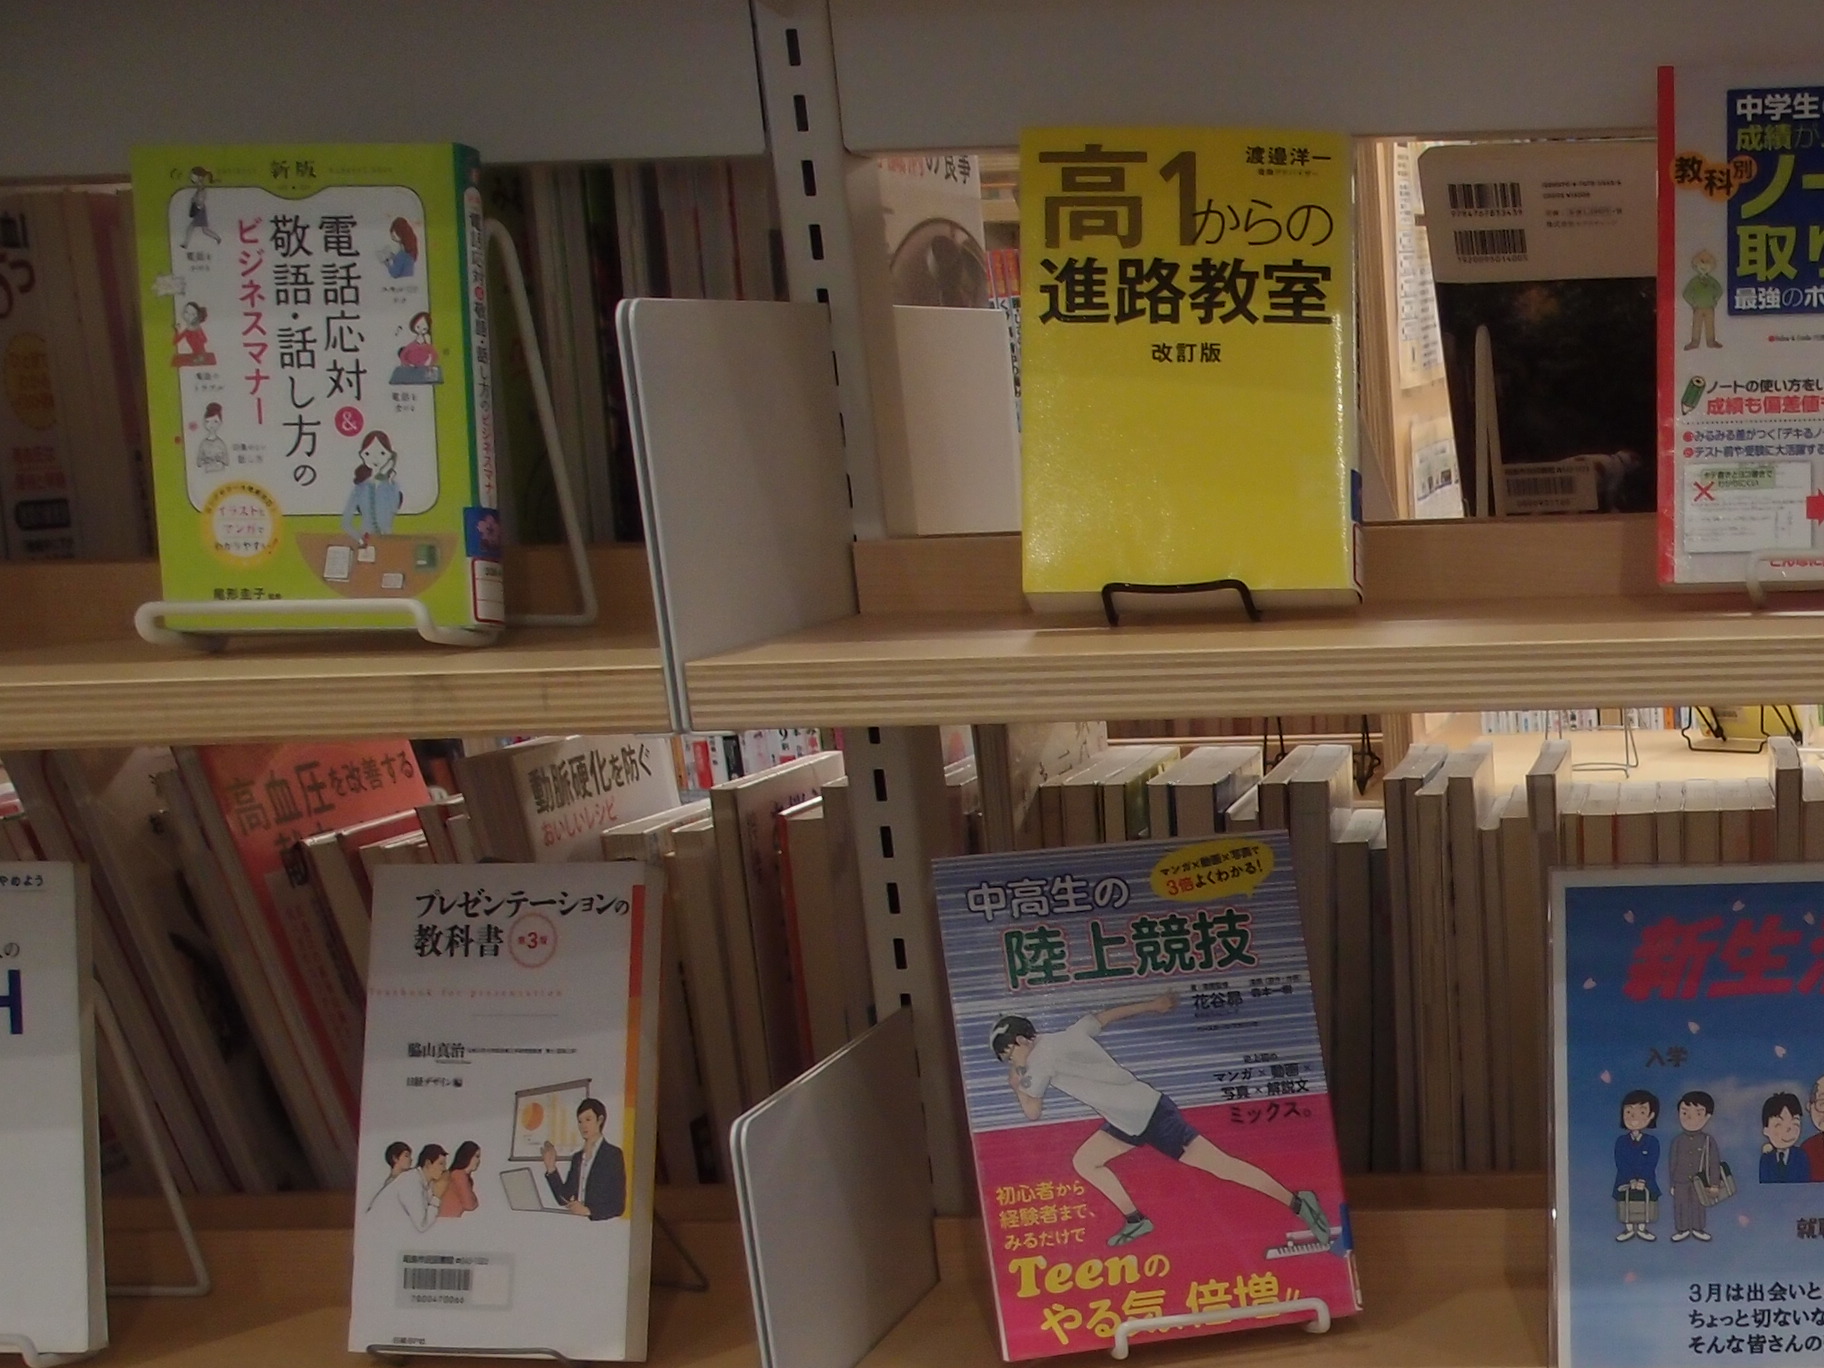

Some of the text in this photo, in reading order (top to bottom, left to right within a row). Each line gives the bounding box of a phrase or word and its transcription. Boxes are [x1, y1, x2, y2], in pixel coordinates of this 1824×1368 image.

[271, 160, 317, 180] 新版
[1039, 257, 1333, 326] 進路教室
[237, 217, 270, 425] ビジネスマナー
[270, 213, 320, 487] 敬語・話し方の
[1151, 342, 1222, 364] 改訂版
[228, 750, 415, 837] 高血圧を改善する
[528, 743, 654, 815] 動脈硬化を防ぐ
[542, 800, 619, 848] おいしいレシピ
[415, 890, 631, 920] プレゼンテーションの
[965, 874, 1131, 922] 中高生の
[414, 922, 505, 958] 教科書
[1001, 906, 1262, 993] 陸上競技
[1644, 1046, 1689, 1068] 入学
[994, 1181, 1086, 1207] 初心者から
[1003, 1227, 1087, 1252] みるだけで
